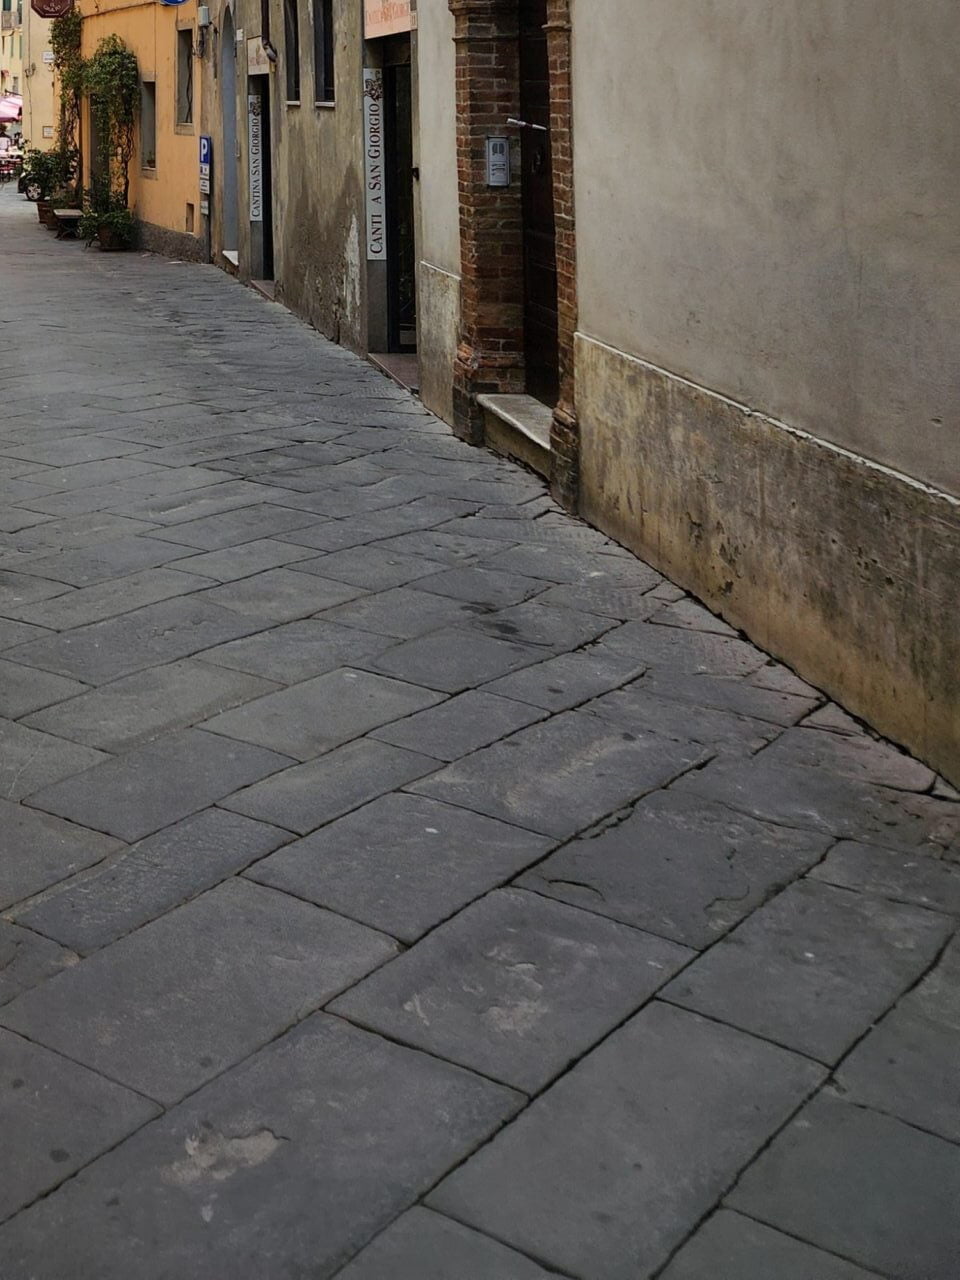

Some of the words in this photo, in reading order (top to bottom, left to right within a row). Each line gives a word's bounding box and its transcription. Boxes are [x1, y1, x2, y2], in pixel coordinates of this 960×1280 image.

[250, 117, 260, 155] GIORGIO
[368, 103, 381, 159] GIORGIO
[201, 138, 208, 162] P
[251, 158, 260, 176] SAN
[368, 164, 382, 191] SAN
[251, 179, 261, 217] CANTINA
